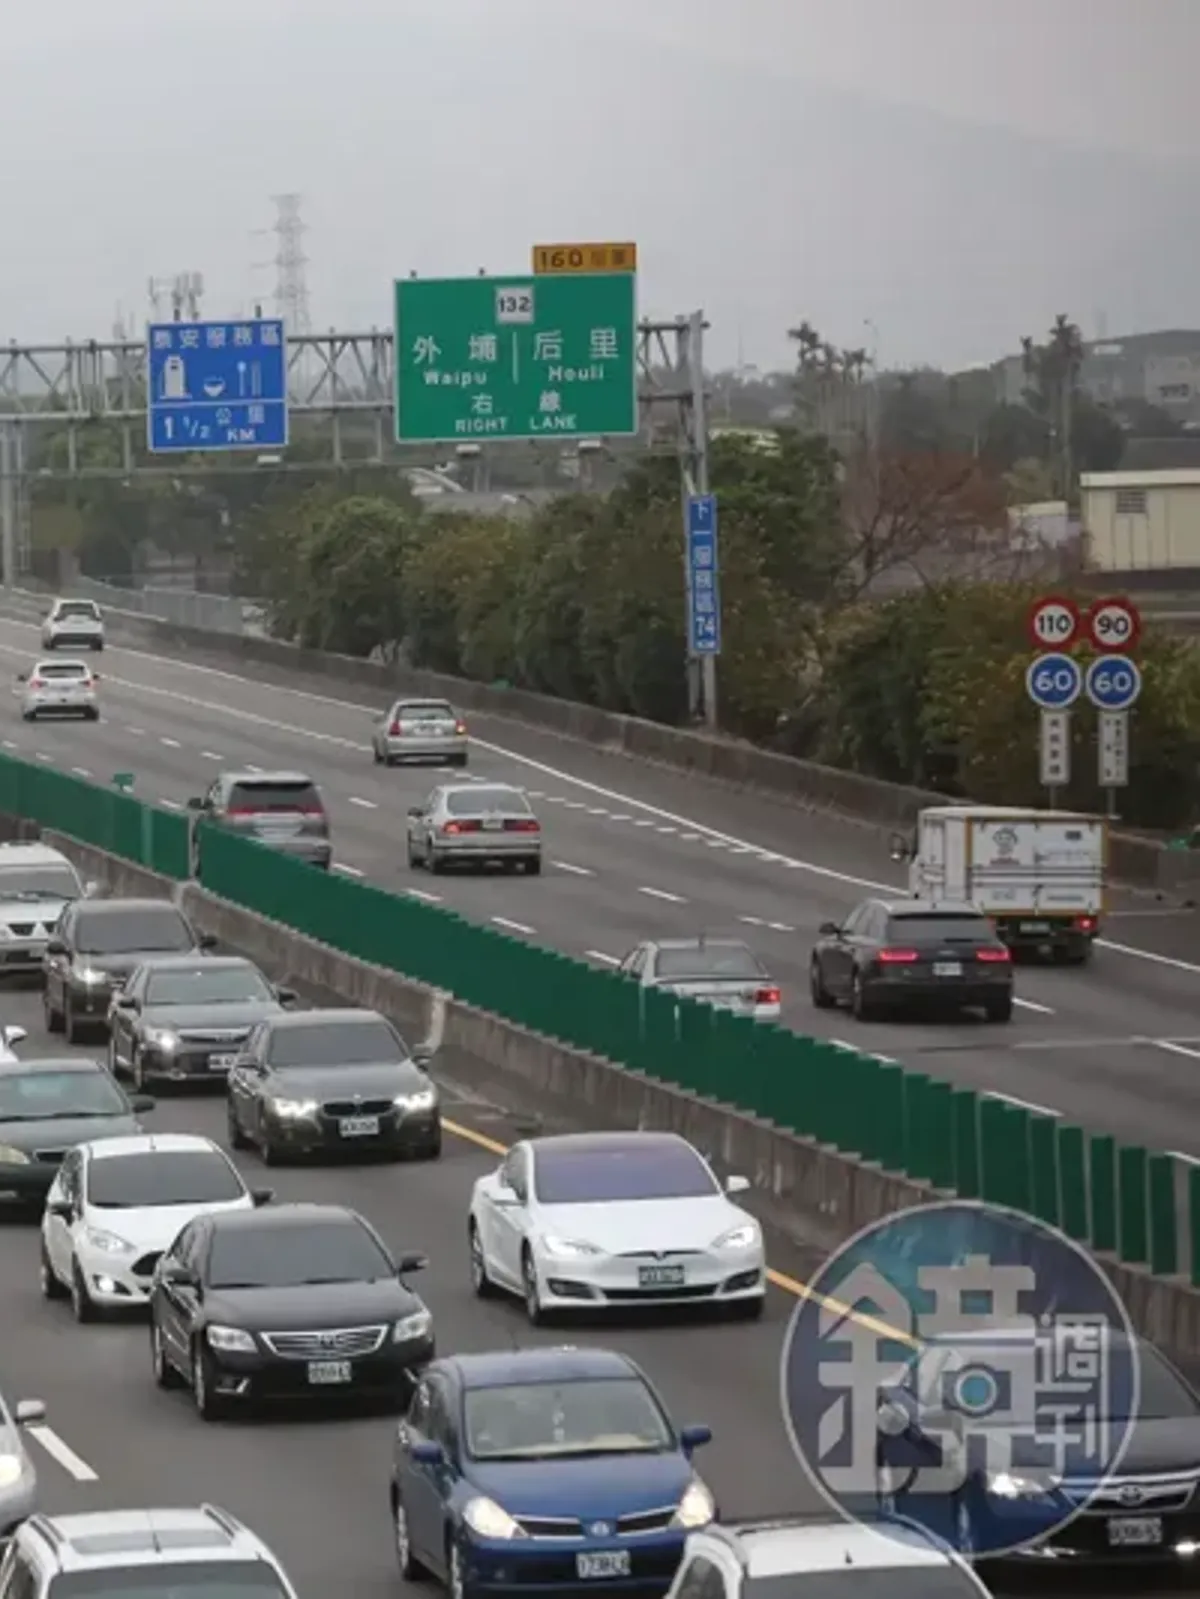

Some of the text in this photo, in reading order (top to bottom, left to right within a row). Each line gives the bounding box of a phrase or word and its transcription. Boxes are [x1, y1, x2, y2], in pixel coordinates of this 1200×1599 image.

[538, 250, 583, 273] 160
[499, 295, 531, 313] 132
[533, 327, 619, 361] 后里
[424, 370, 487, 388] Waipu
[548, 365, 604, 382] Houli
[455, 414, 577, 433] RIGHT LANE
[227, 429, 256, 442] KM
[1039, 614, 1071, 633] 110
[1097, 615, 1129, 635] 90
[1035, 671, 1073, 691] 60
[1094, 672, 1132, 692] 60
